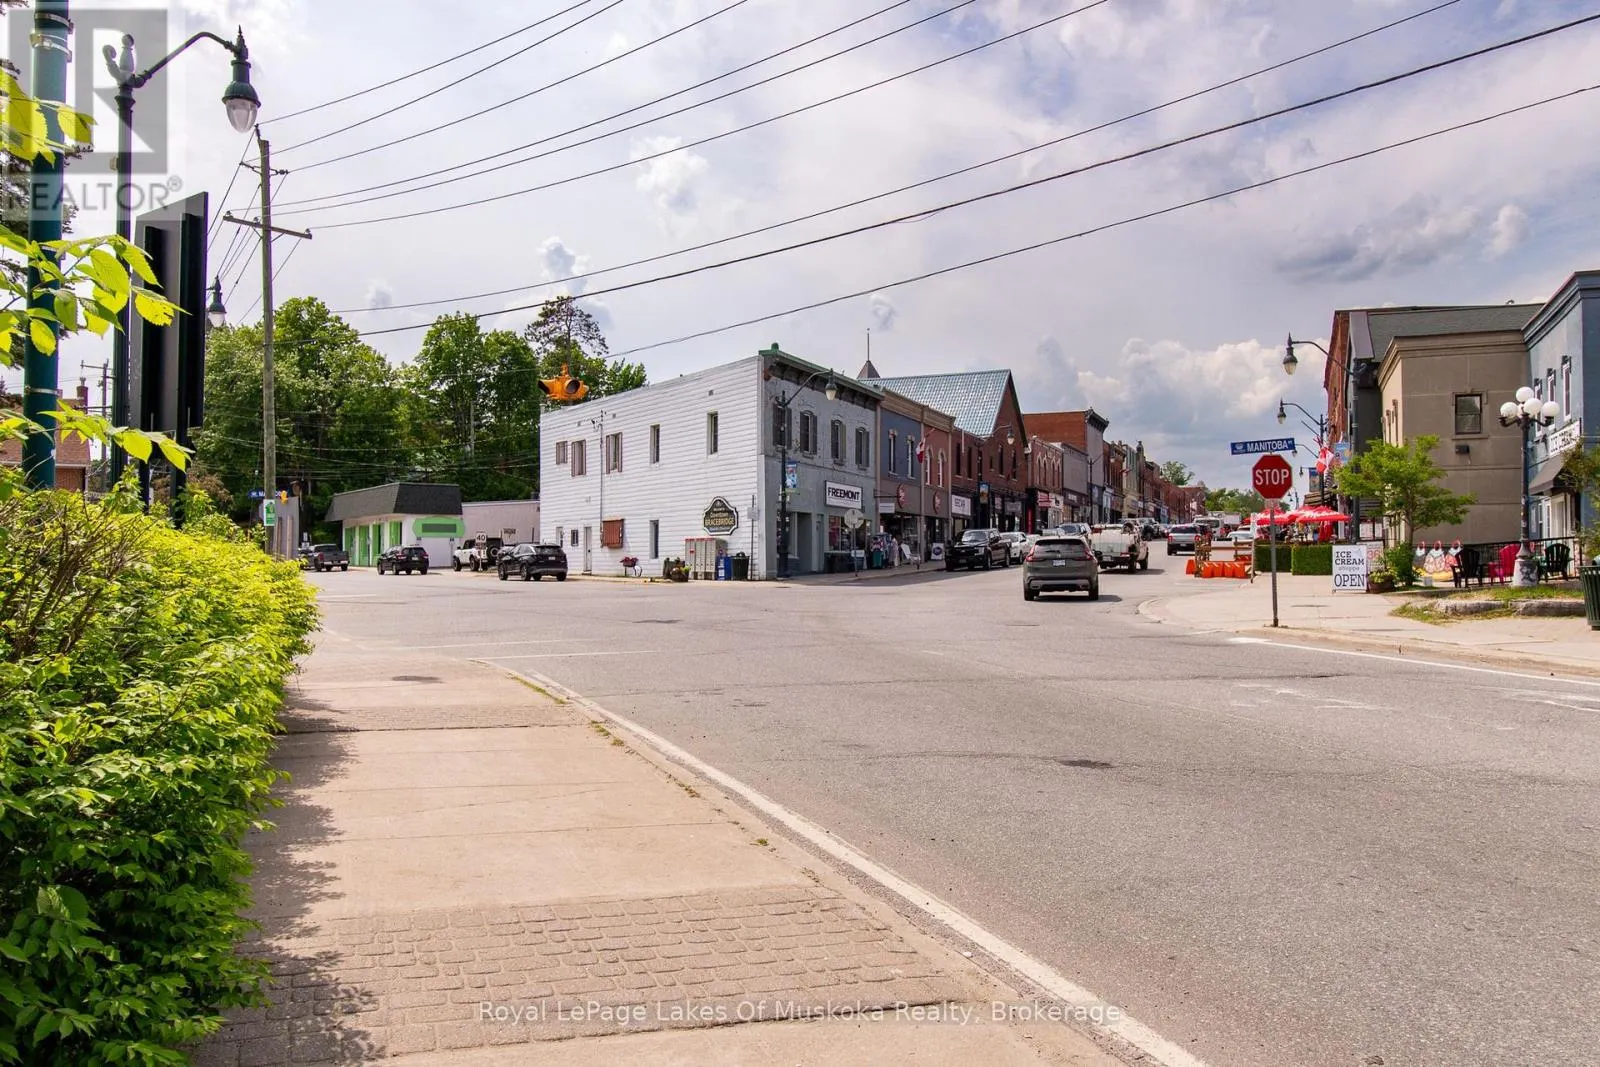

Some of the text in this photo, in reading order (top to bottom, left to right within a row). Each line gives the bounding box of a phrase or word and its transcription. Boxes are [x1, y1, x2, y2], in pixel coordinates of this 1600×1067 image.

[1247, 440, 1289, 453] MANITOBA
[1255, 469, 1289, 486] STOP
[827, 487, 860, 501] FREEMONT
[1334, 574, 1365, 587] OPEN
